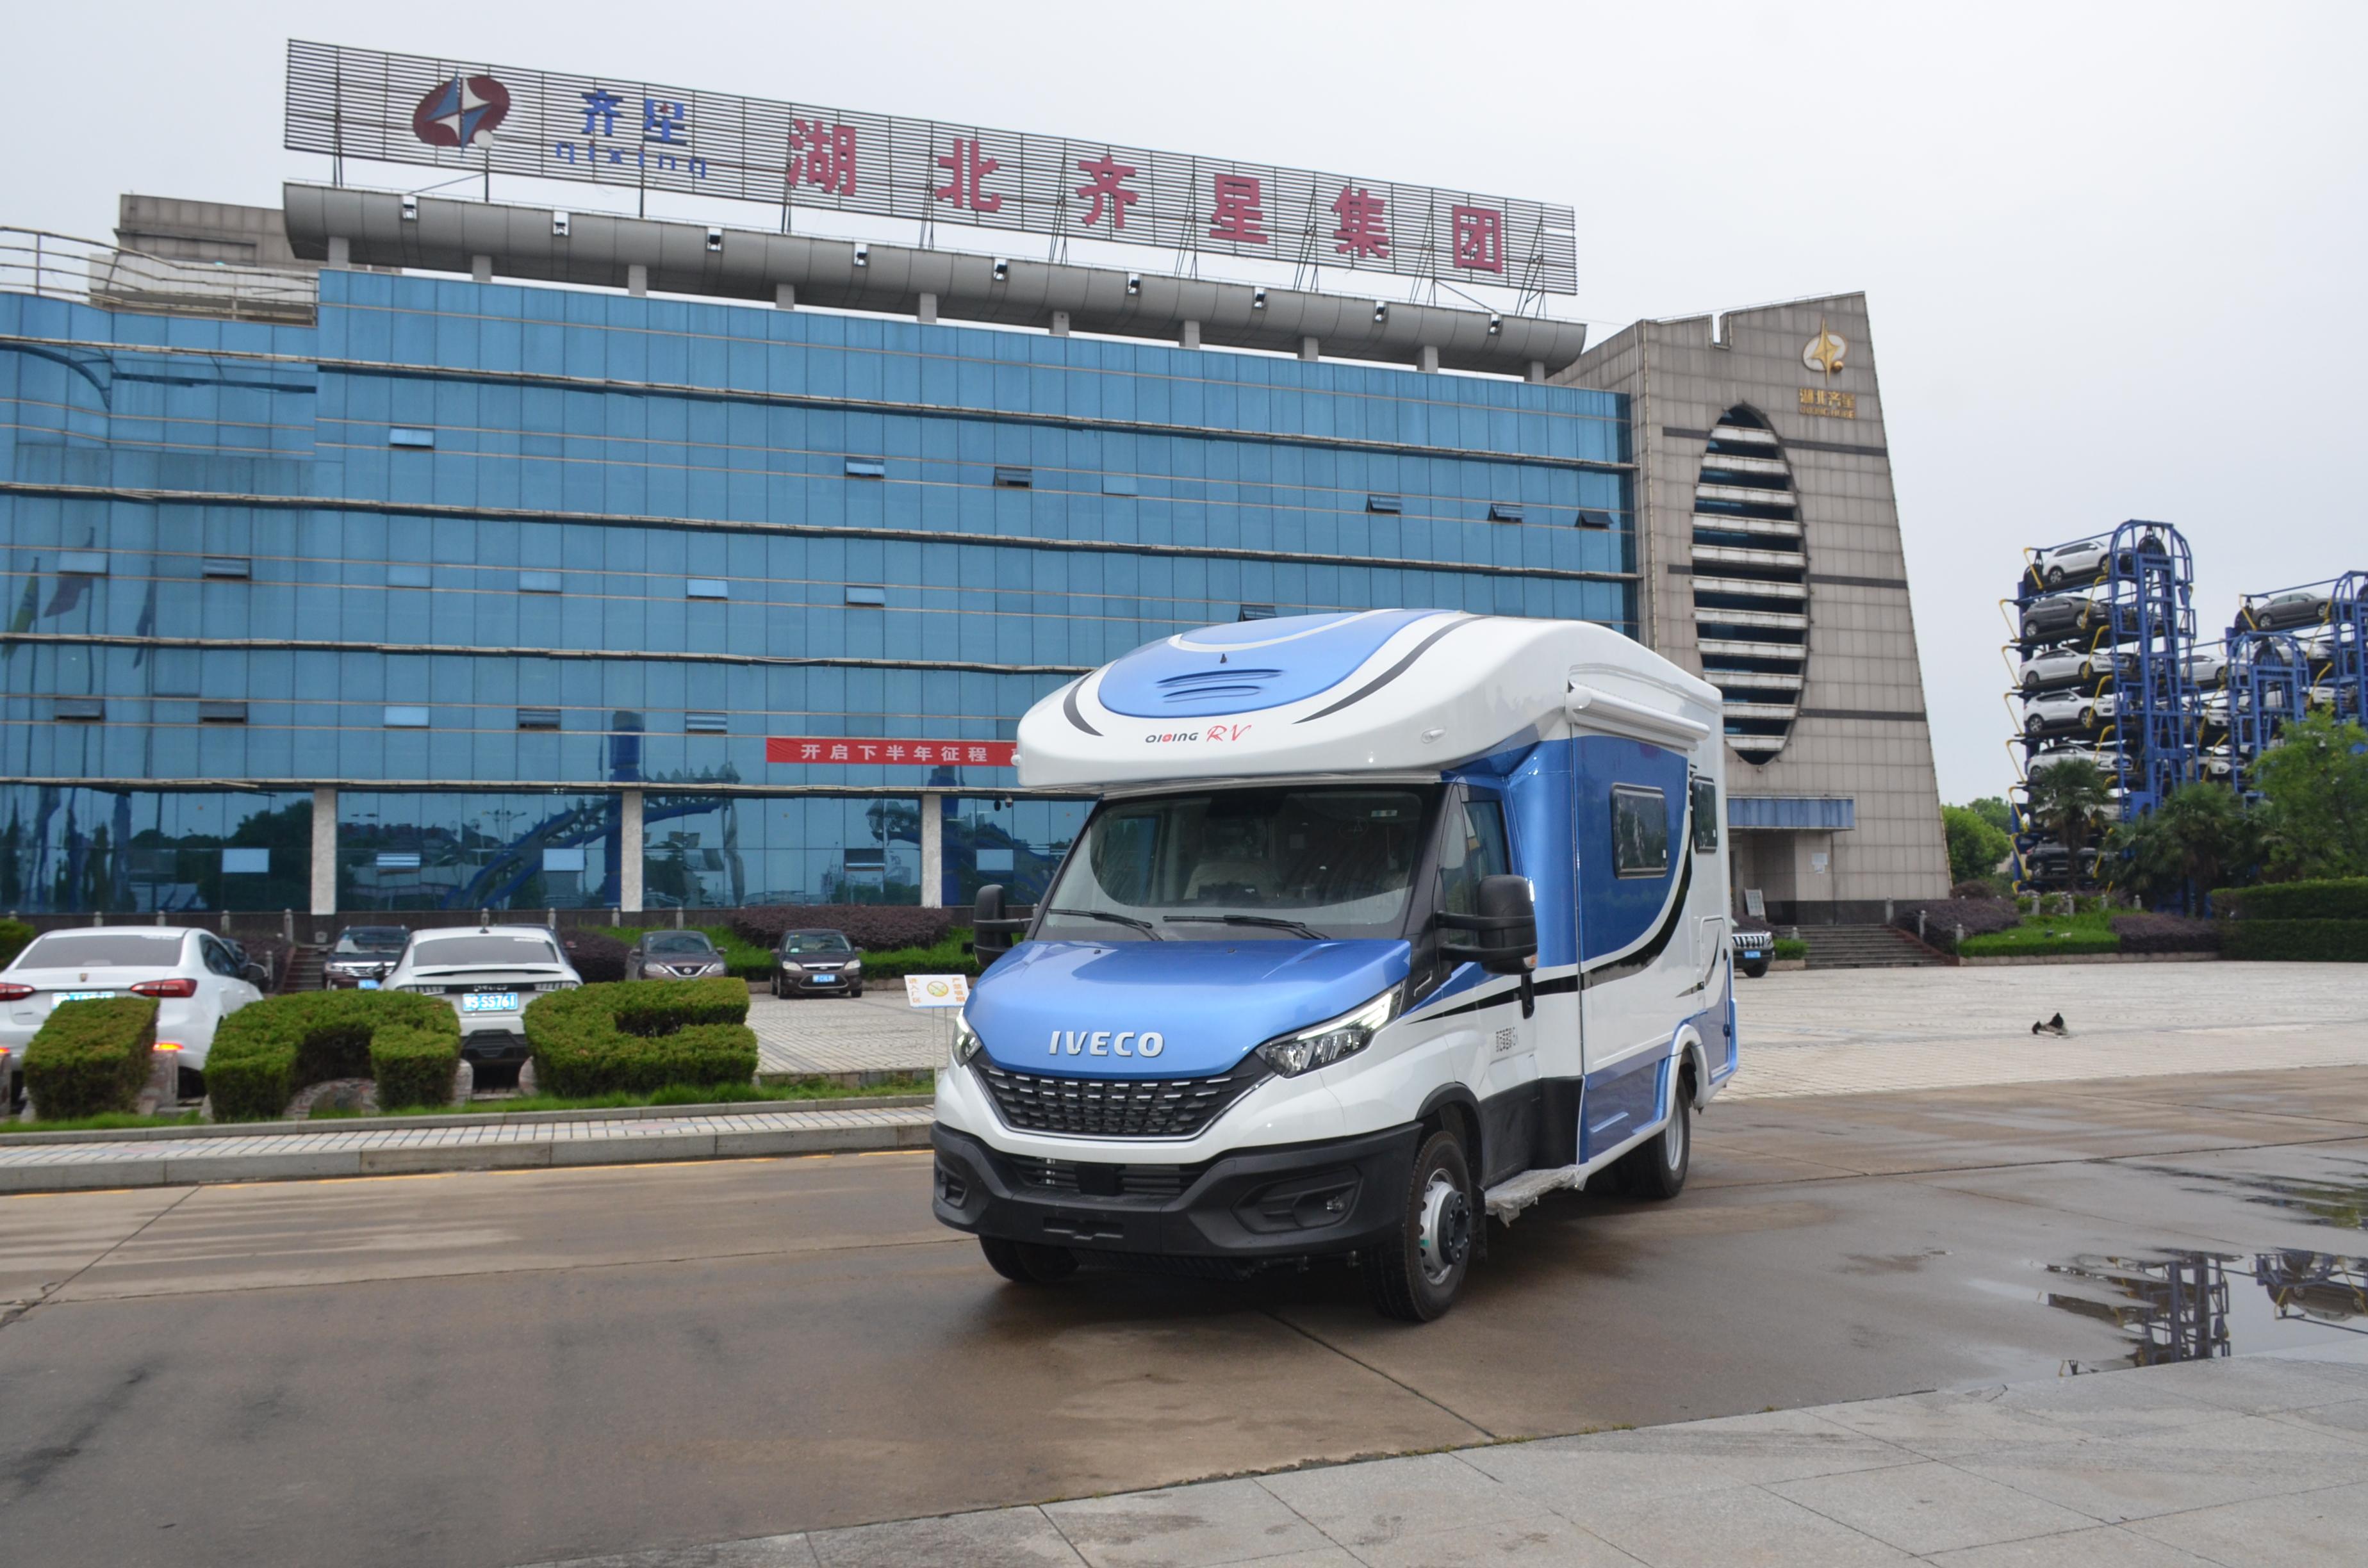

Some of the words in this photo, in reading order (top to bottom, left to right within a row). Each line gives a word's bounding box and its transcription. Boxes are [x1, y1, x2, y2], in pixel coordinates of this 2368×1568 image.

[579, 88, 688, 146] 齐星
[787, 118, 1502, 274] 湖北齐星集团
[1206, 724, 1252, 742] RV
[801, 743, 988, 763] 开启下半年征程
[1049, 1031, 1165, 1058] IVECO
